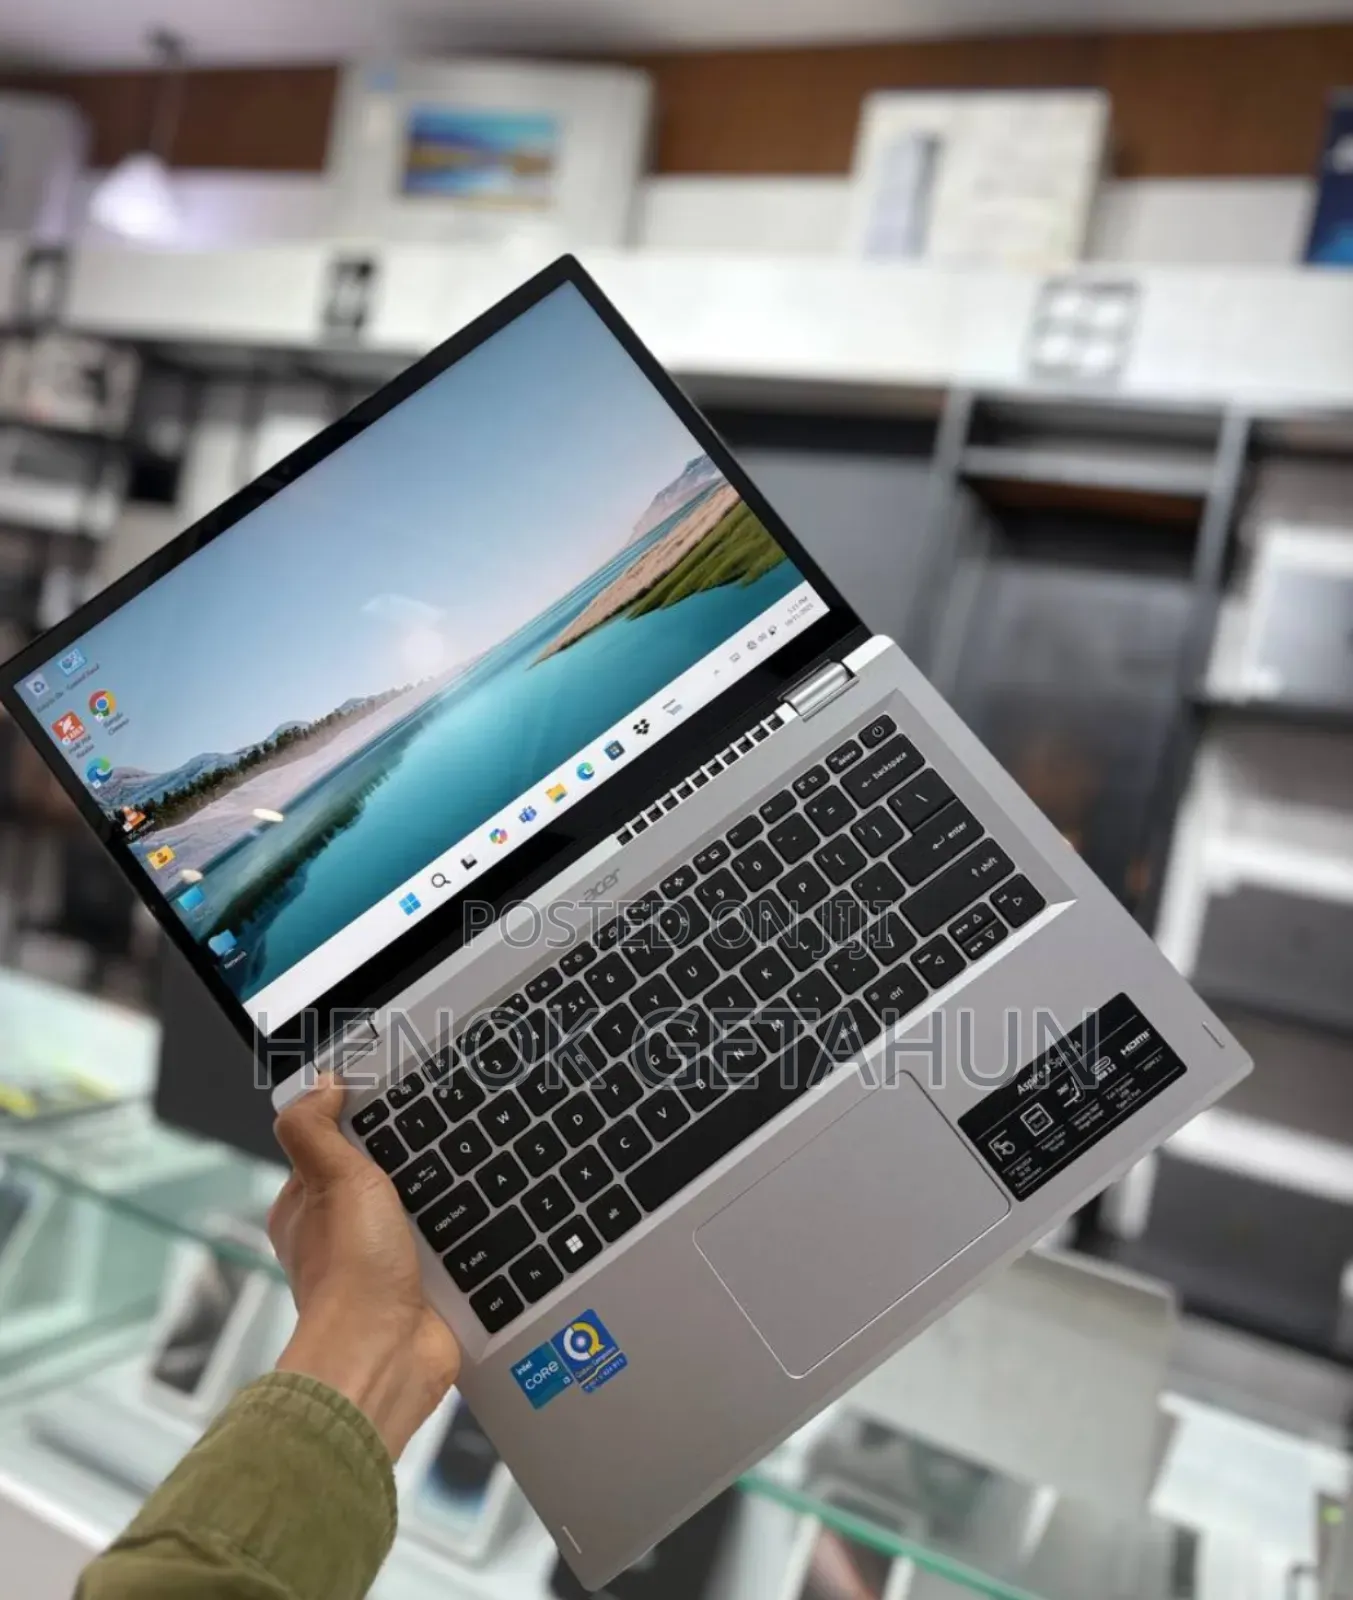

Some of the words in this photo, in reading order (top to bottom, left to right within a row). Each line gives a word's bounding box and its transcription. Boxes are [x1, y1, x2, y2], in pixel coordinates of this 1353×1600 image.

[871, 751, 908, 780] backspace
[947, 821, 968, 839] enter
[980, 857, 999, 872] shift
[583, 868, 621, 903] acer
[798, 882, 807, 893] P
[715, 888, 725, 899] 9
[799, 940, 810, 950] L
[605, 972, 616, 984] 6
[686, 965, 699, 978] U
[760, 967, 773, 980] K
[889, 986, 904, 1000] ctrl
[649, 994, 660, 1006] Y
[727, 996, 735, 1008] J
[567, 1001, 578, 1013] 5
[611, 1023, 623, 1035] T
[685, 1024, 699, 1038] H
[1119, 1029, 1151, 1056] HDMI
[491, 1060, 502, 1071] 3
[650, 1054, 661, 1066] G
[536, 1082, 548, 1095] E
[1016, 1068, 1045, 1096] Aspire
[453, 1089, 464, 1101] 2
[610, 1083, 621, 1096] F
[362, 1111, 376, 1124] esc
[496, 1110, 510, 1124] W
[656, 1106, 668, 1119] V
[416, 1118, 425, 1128] 1
[572, 1113, 584, 1126] D
[459, 1141, 472, 1154] Q
[534, 1143, 545, 1155] S
[619, 1136, 631, 1149] C
[496, 1174, 508, 1186] A
[580, 1167, 592, 1180] X
[408, 1182, 422, 1195] tab
[541, 1197, 553, 1210] Z
[434, 1216, 452, 1232] caps
[450, 1204, 468, 1219] lock
[608, 1208, 620, 1220] alt
[469, 1250, 488, 1267] shift
[529, 1269, 542, 1280] fn
[489, 1297, 504, 1312] ctrl
[515, 1359, 533, 1376] intel
